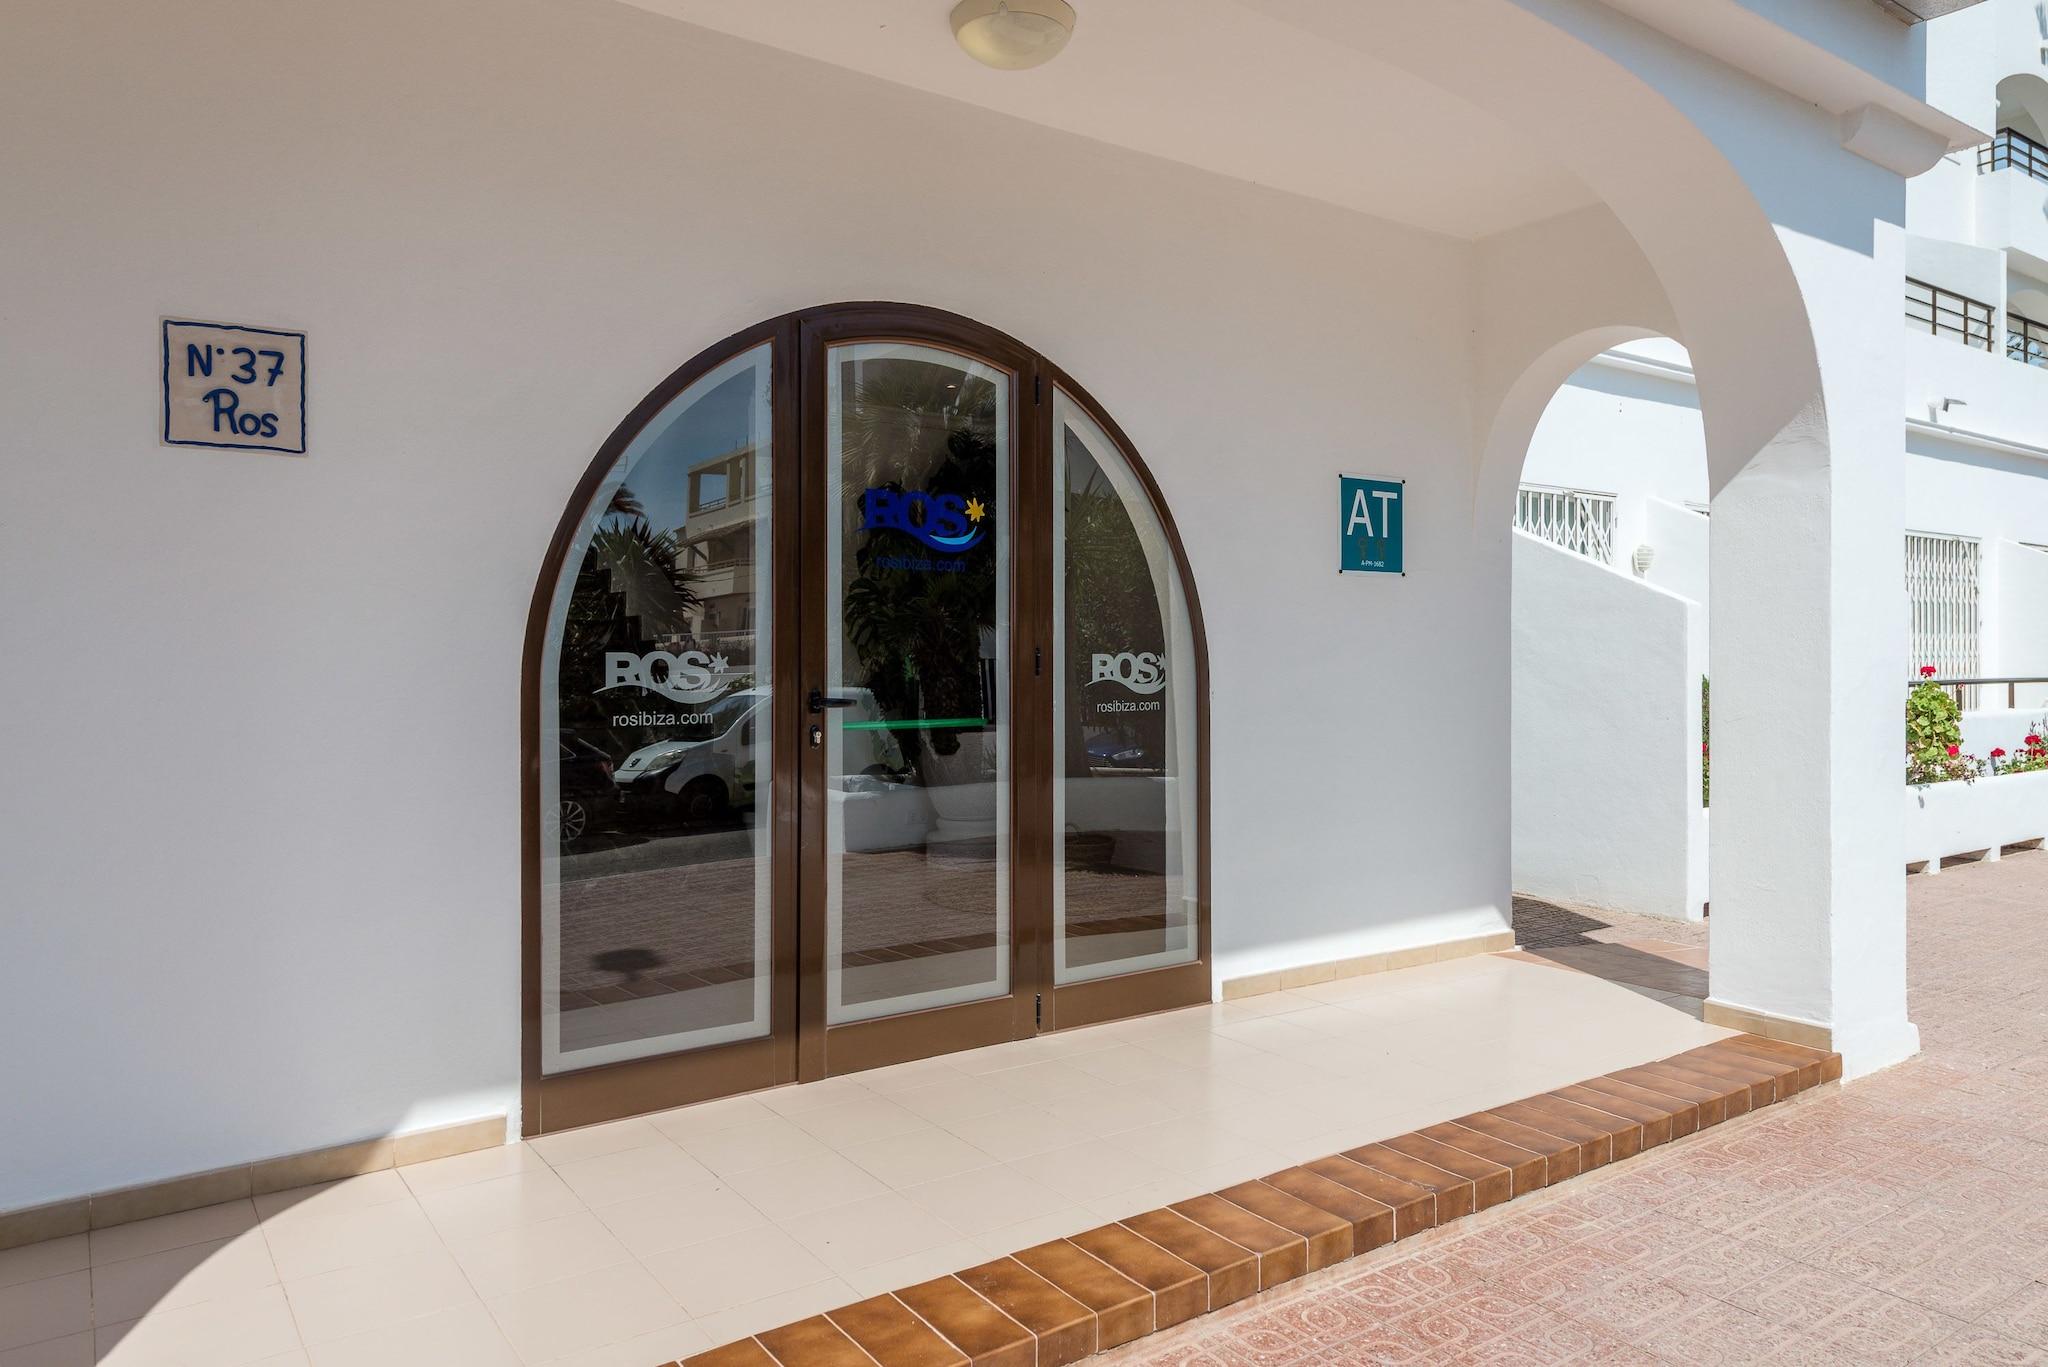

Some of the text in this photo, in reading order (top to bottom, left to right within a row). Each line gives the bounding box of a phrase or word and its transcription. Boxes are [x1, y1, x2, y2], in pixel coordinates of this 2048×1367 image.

[231, 347, 284, 387] 37
[202, 388, 279, 438] Ros
[864, 488, 968, 540] ROS
[1346, 488, 1398, 538] AT
[605, 650, 712, 690] ROS
[1092, 651, 1159, 685] ROS
[612, 711, 714, 727] rosibiza.com
[1096, 700, 1160, 713] rosibiza.com
